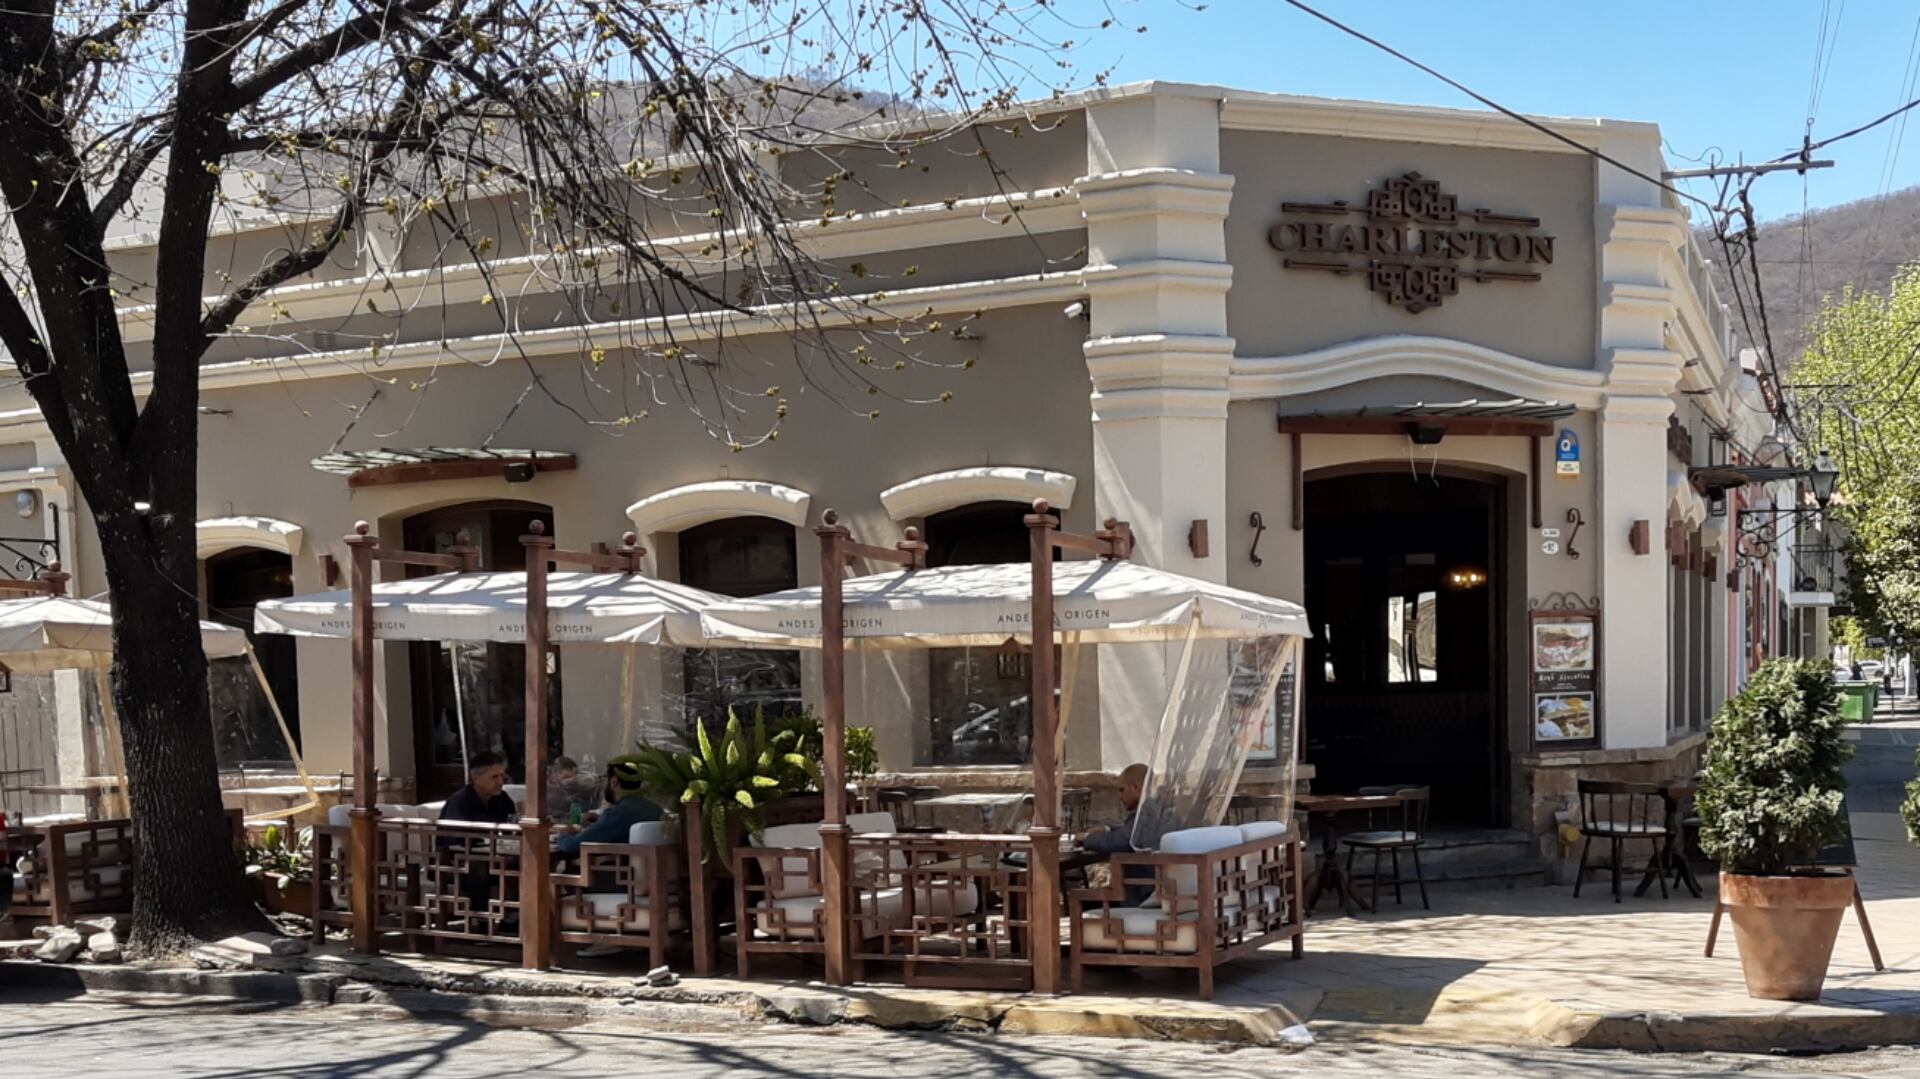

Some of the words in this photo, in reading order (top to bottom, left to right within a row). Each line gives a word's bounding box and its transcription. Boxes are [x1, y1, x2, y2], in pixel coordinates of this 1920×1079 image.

[1267, 221, 1557, 265] CHARLESTON
[997, 613, 1030, 624] ANDE
[1064, 605, 1110, 620] ORIGEN
[321, 621, 351, 629] ANDES
[554, 624, 592, 633] ORIGEN
[778, 619, 815, 629] ANDES
